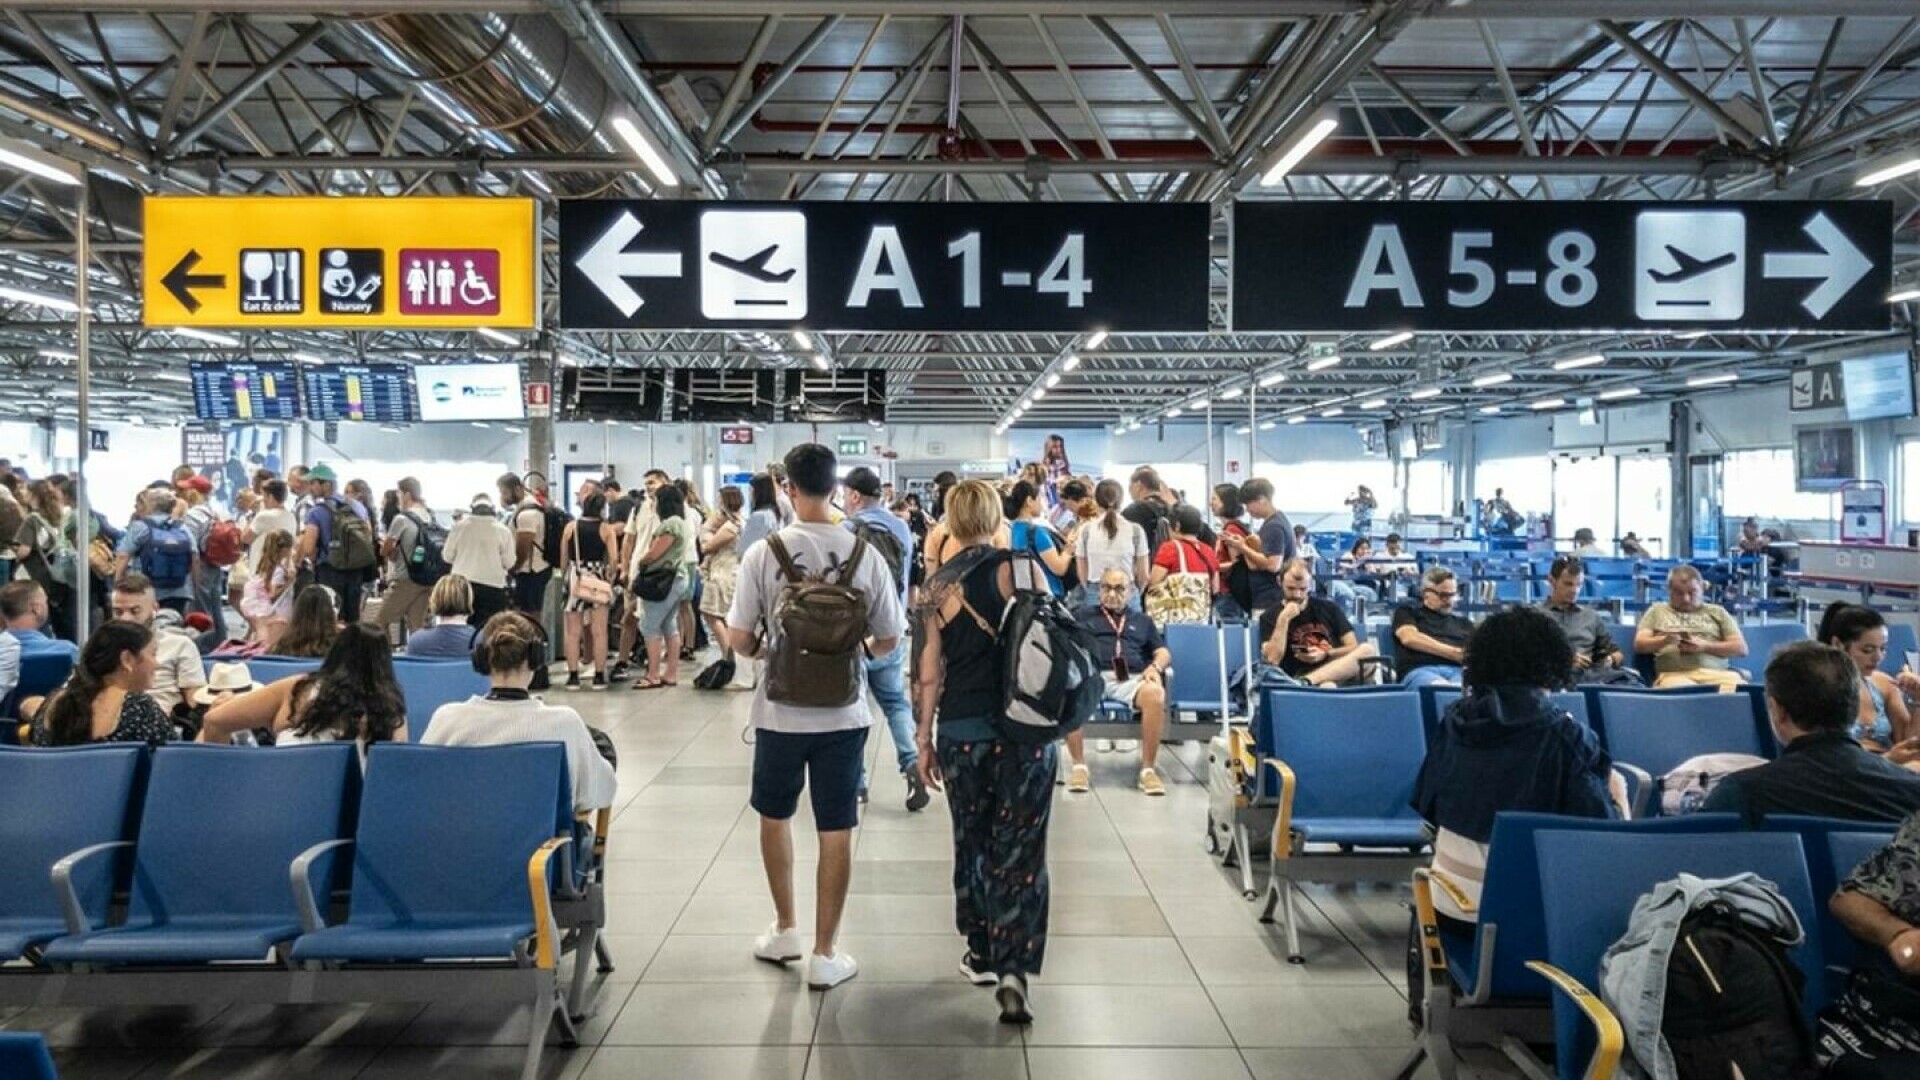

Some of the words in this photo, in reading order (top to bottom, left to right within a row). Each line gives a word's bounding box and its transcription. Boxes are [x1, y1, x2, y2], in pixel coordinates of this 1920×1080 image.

[846, 225, 924, 307] A
[948, 231, 1093, 308] 1-4
[1343, 224, 1425, 308] A
[1447, 231, 1599, 308] 5-8
[243, 301, 260, 312] Eat
[262, 302, 272, 312] &
[273, 301, 301, 312] drink
[332, 301, 372, 314] Nursery
[1820, 371, 1835, 401] A
